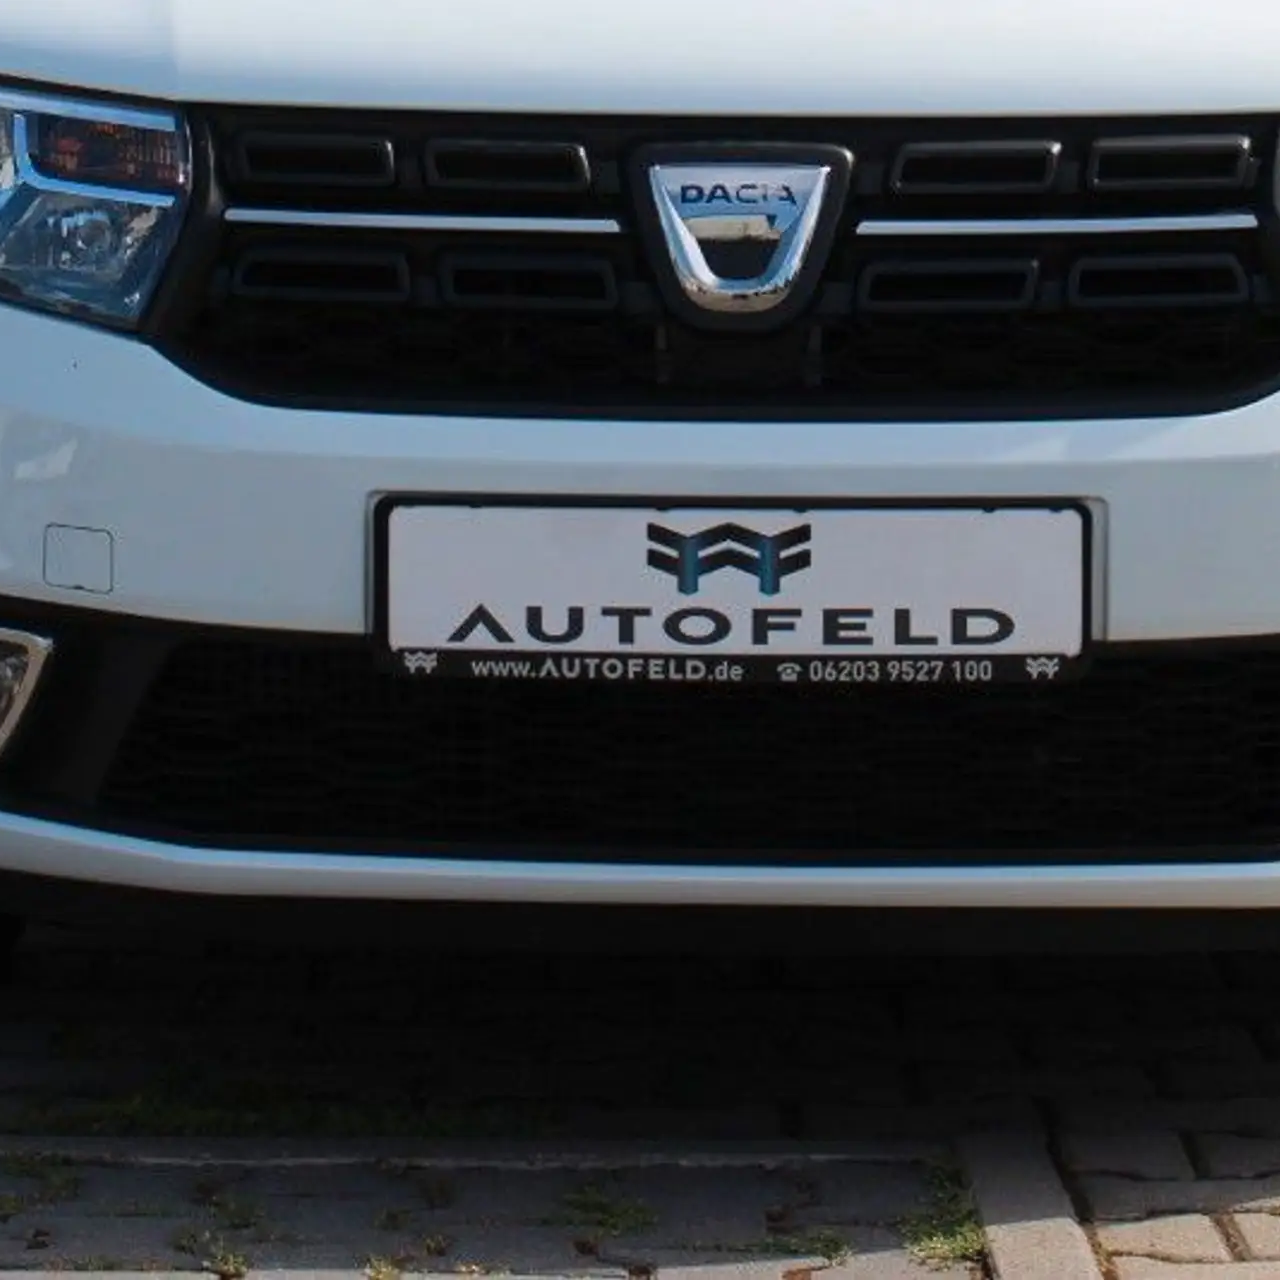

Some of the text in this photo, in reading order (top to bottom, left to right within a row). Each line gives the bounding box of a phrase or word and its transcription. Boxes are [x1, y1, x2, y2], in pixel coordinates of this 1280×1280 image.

[680, 183, 797, 205] DACIA
[447, 604, 1016, 645] AUTOFELD
[471, 658, 744, 681] www.AUTOFELD.de
[809, 660, 993, 681] 06203 9527 100
